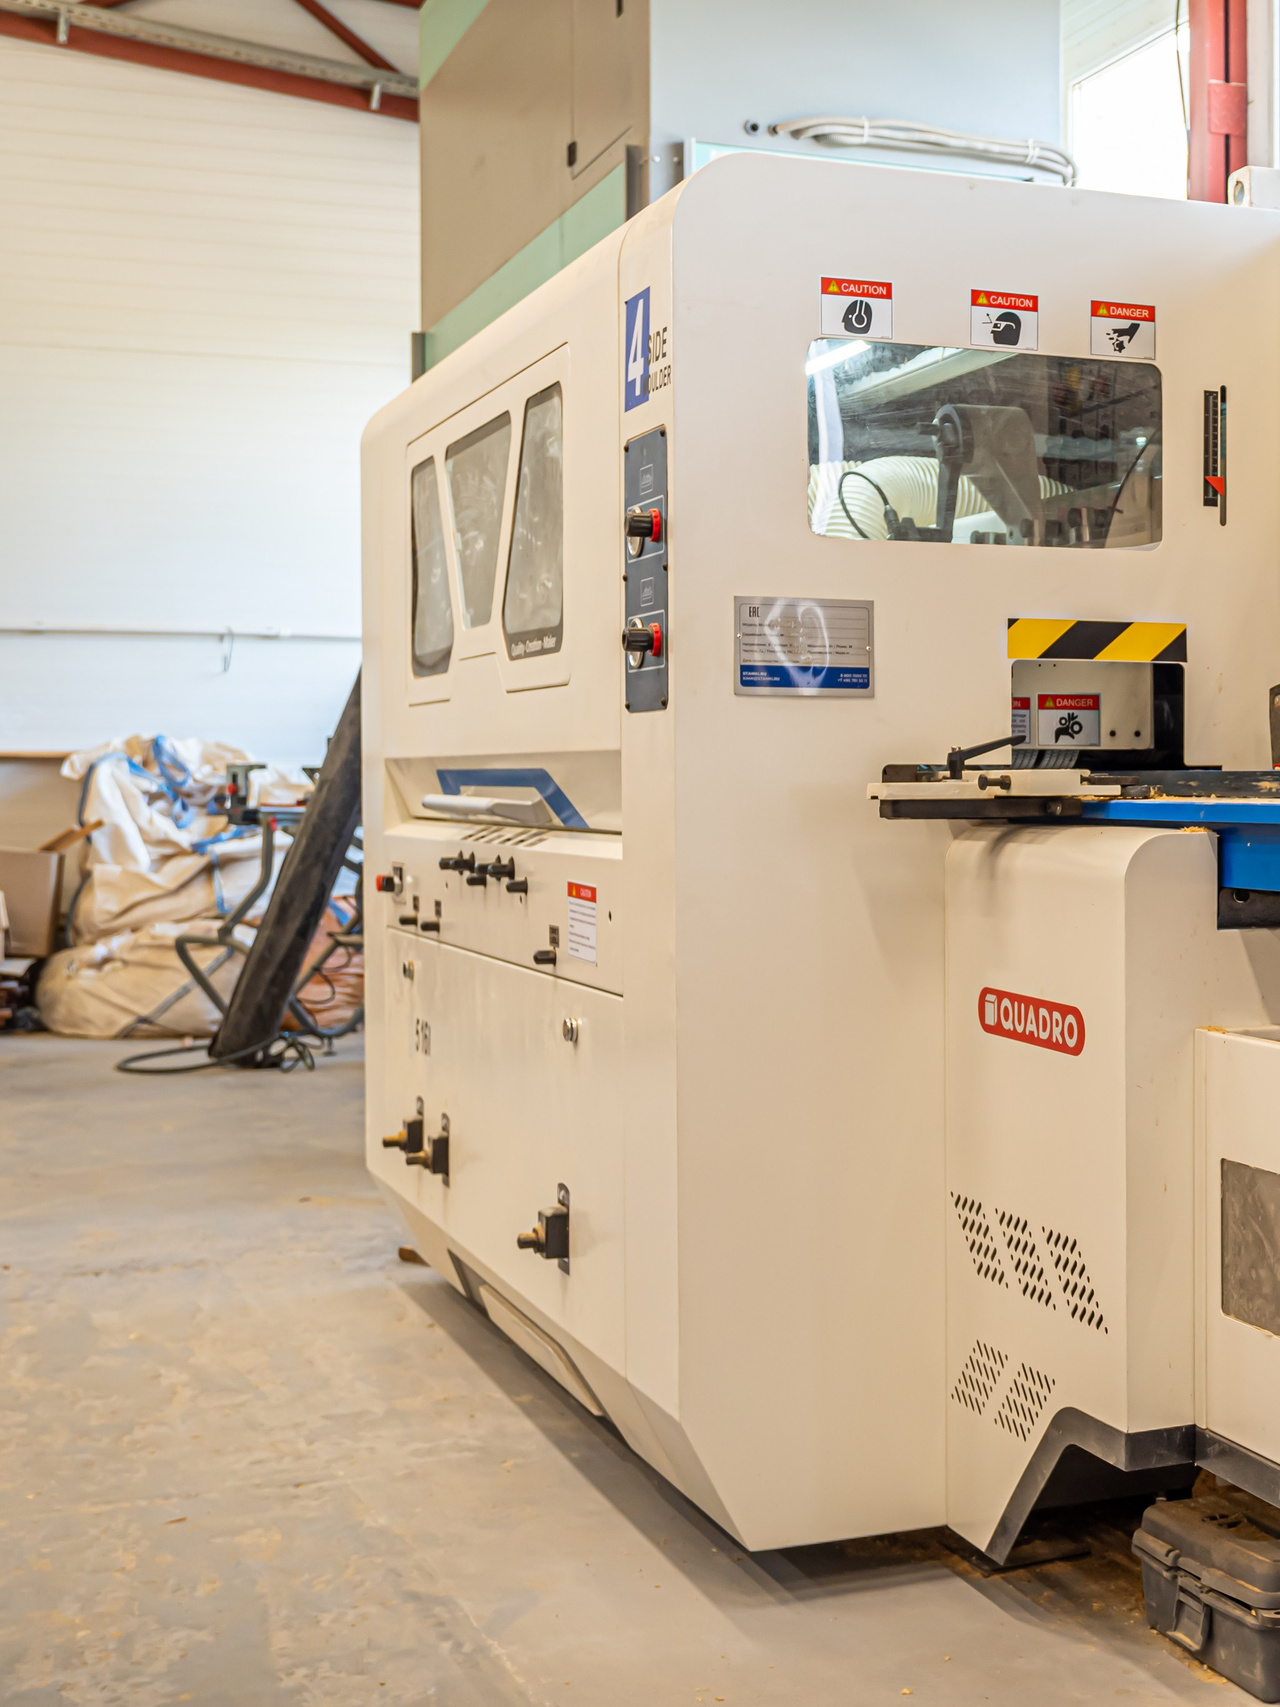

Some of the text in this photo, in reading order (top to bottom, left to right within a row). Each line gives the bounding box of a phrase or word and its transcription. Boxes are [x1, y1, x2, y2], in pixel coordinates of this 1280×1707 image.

[841, 283, 887, 295] CAUTION
[989, 295, 1033, 307] CAUTION
[1110, 306, 1149, 318] DANGER
[628, 298, 644, 397] 4
[647, 326, 668, 366] SIDE
[1056, 698, 1093, 707] DANGER
